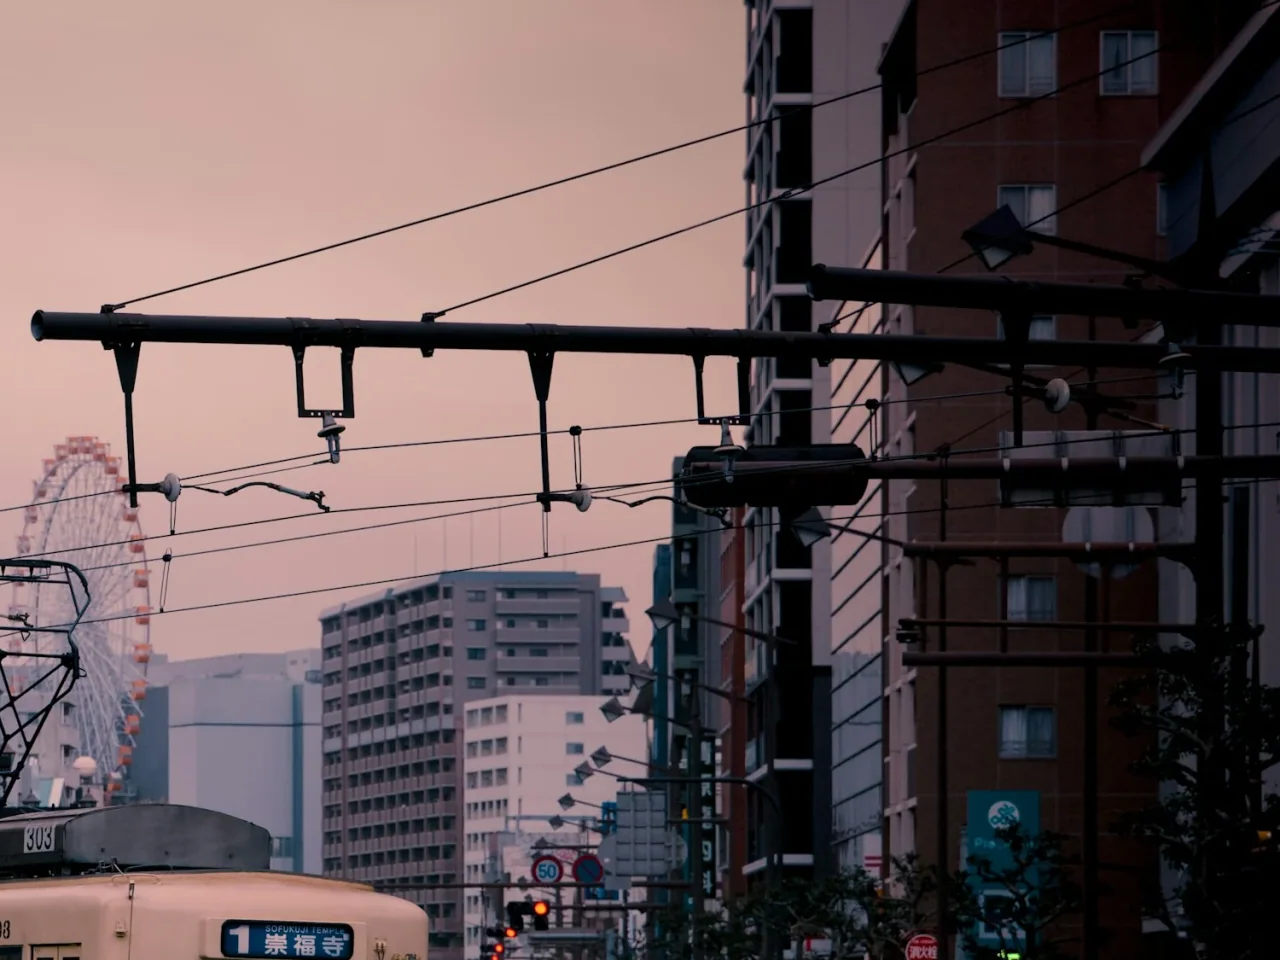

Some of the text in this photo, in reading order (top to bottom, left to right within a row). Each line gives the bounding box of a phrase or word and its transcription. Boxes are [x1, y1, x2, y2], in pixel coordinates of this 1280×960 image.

[26, 826, 52, 850] 303
[538, 864, 557, 879] 50
[229, 925, 250, 954] 1
[264, 925, 345, 935] SOFUKUJI TEMPLE
[264, 933, 345, 957] 崇福寺
